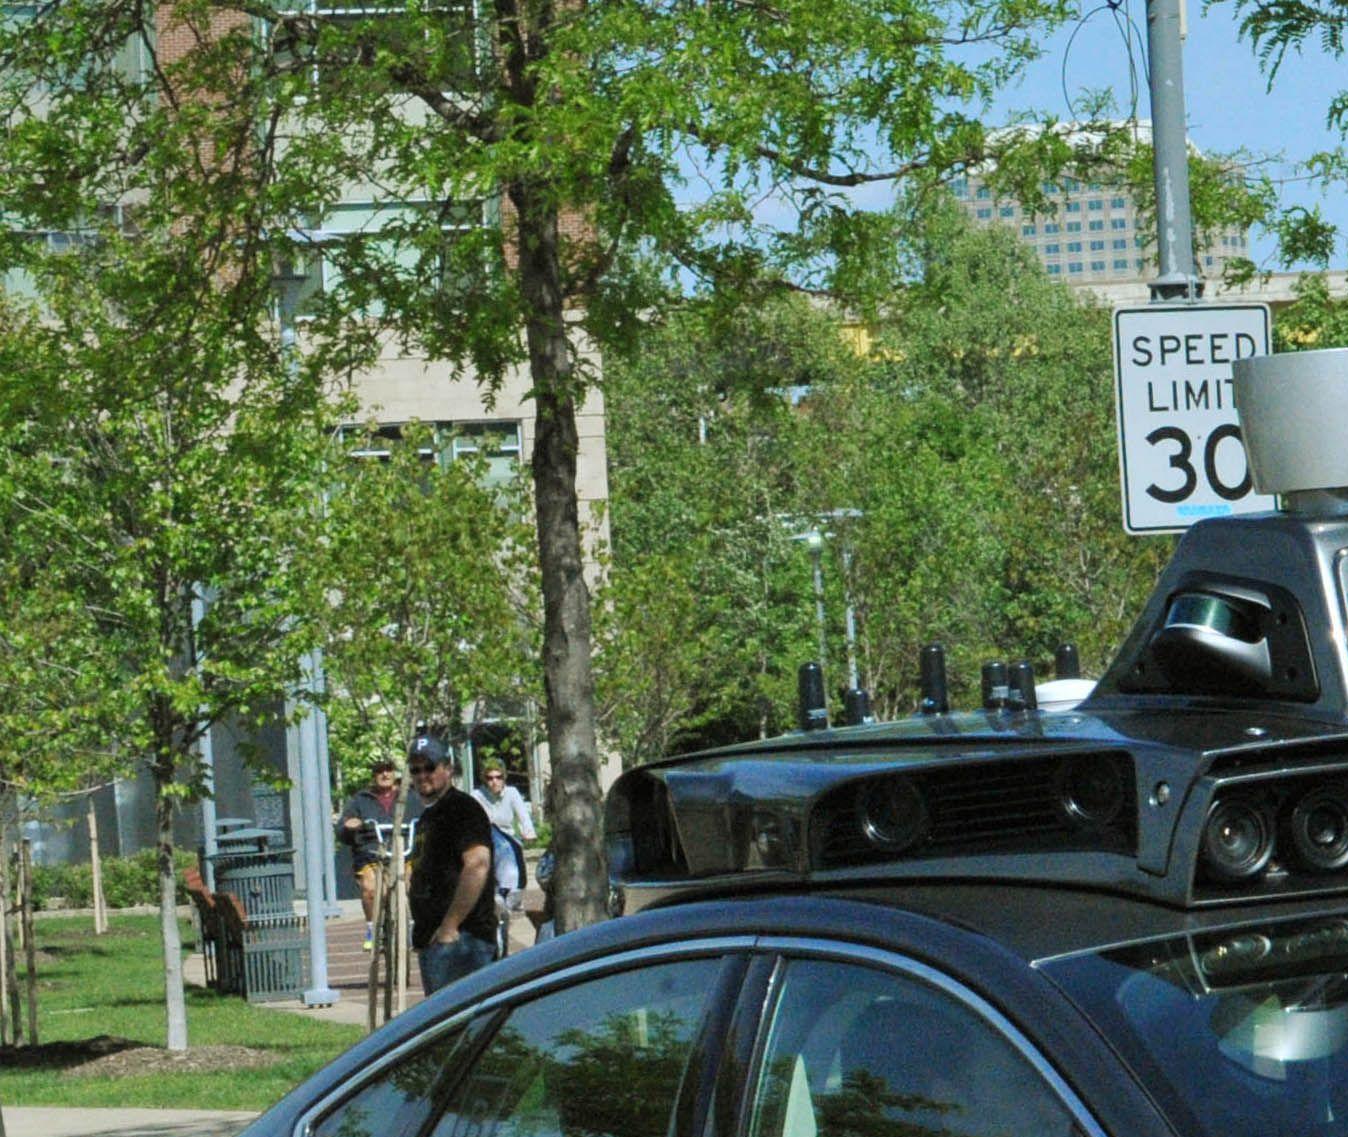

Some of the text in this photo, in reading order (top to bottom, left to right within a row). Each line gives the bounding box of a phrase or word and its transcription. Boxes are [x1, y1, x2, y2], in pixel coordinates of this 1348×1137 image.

[1132, 333, 1257, 367] SPEED
[1145, 424, 1254, 503] 30
[417, 738, 429, 751] P
